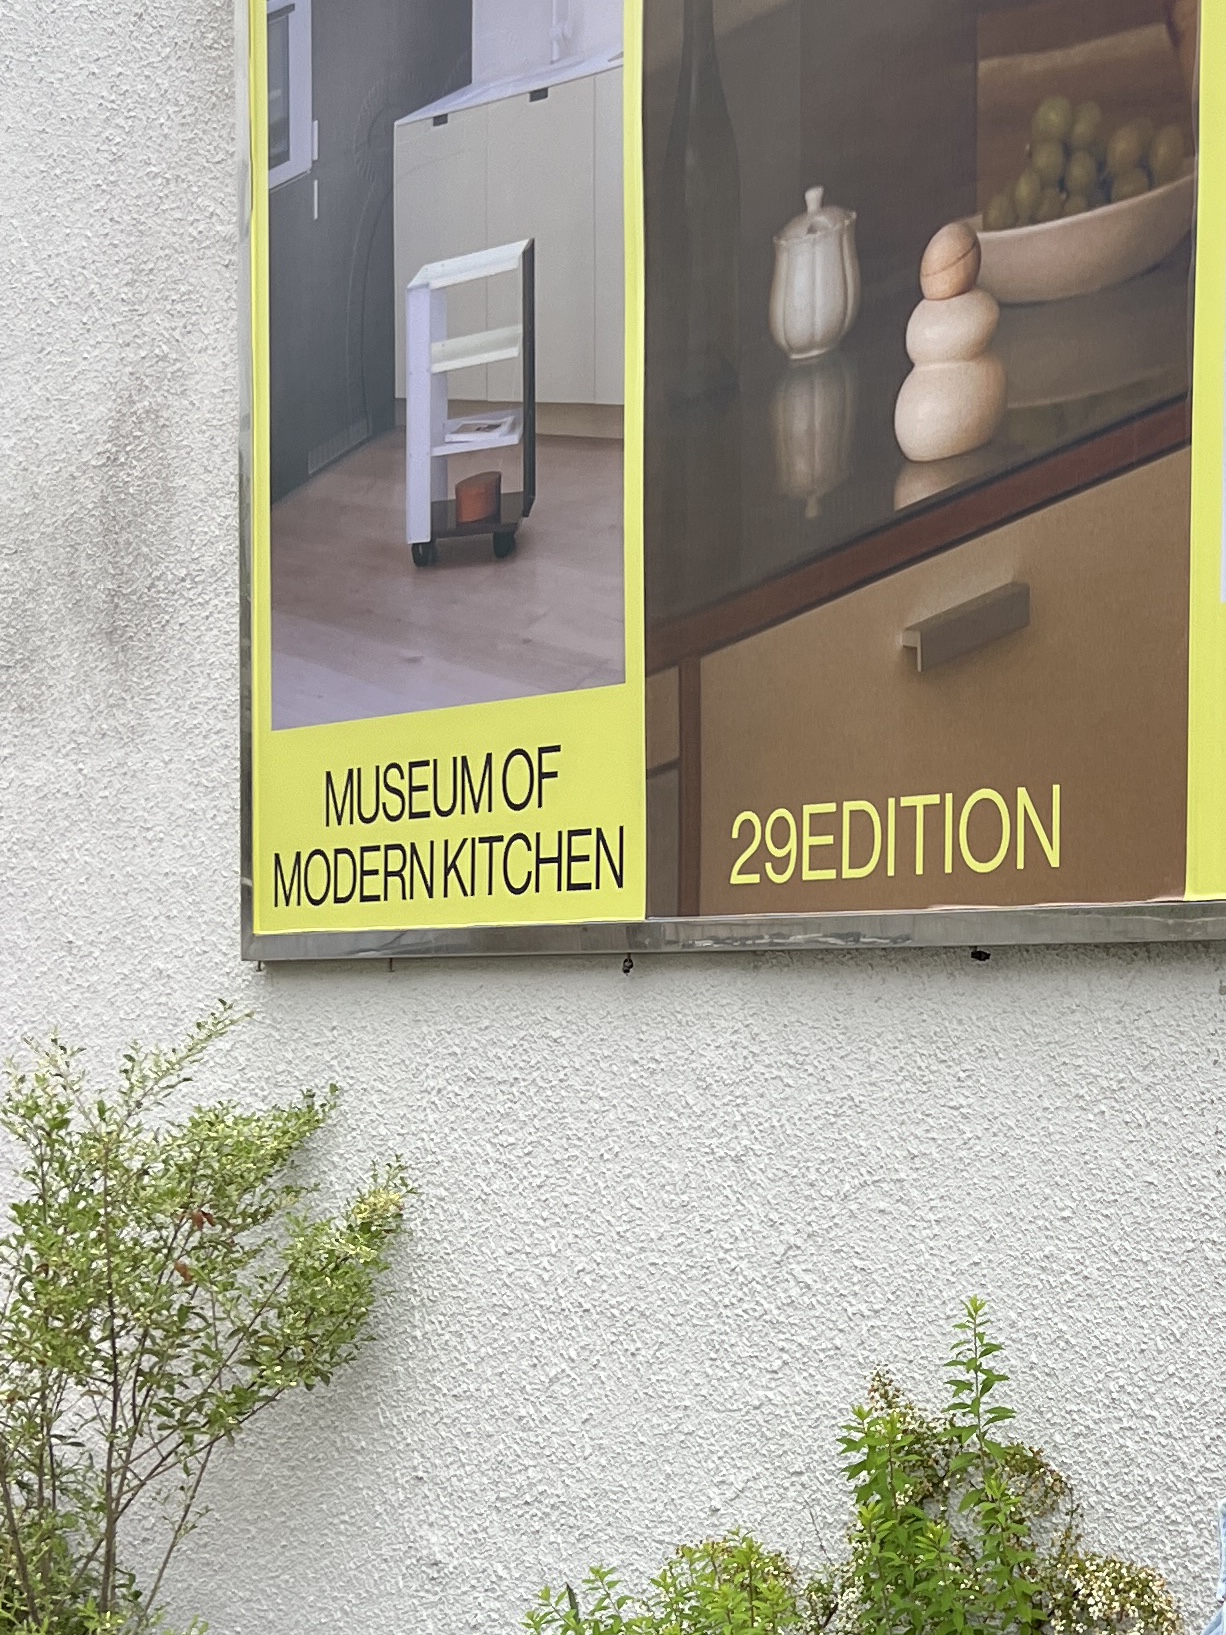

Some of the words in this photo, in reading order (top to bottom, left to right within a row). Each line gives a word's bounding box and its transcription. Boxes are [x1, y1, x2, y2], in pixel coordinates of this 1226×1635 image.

[325, 752, 493, 827] MUSEUM
[501, 744, 561, 812] OF
[274, 840, 435, 908] MODERN
[443, 825, 624, 898] KITCHEN
[729, 783, 1062, 885] 29EDITION
